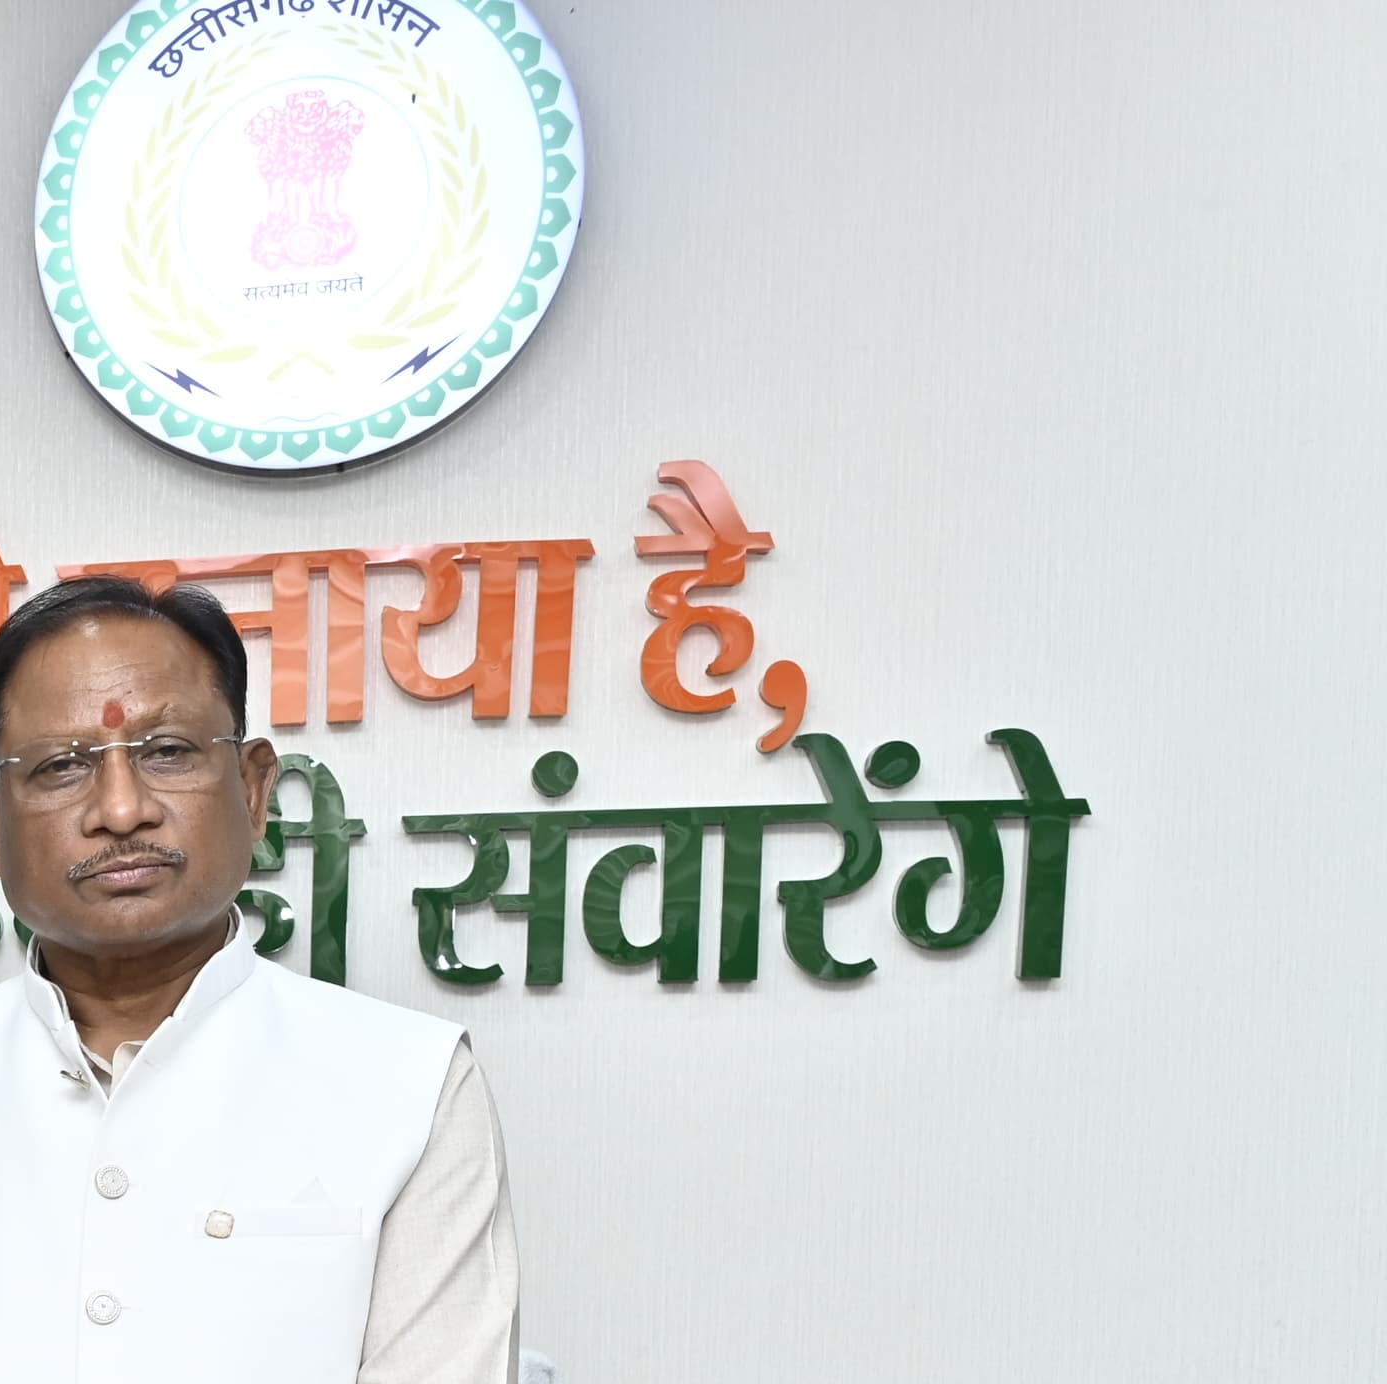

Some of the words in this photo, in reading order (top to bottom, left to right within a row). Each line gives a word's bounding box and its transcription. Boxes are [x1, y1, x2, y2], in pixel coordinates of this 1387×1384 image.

[315, 271, 364, 292] जयते
[55, 538, 597, 727] नाया
[633, 459, 807, 754] है,
[401, 727, 1092, 986] संवारेंगे
